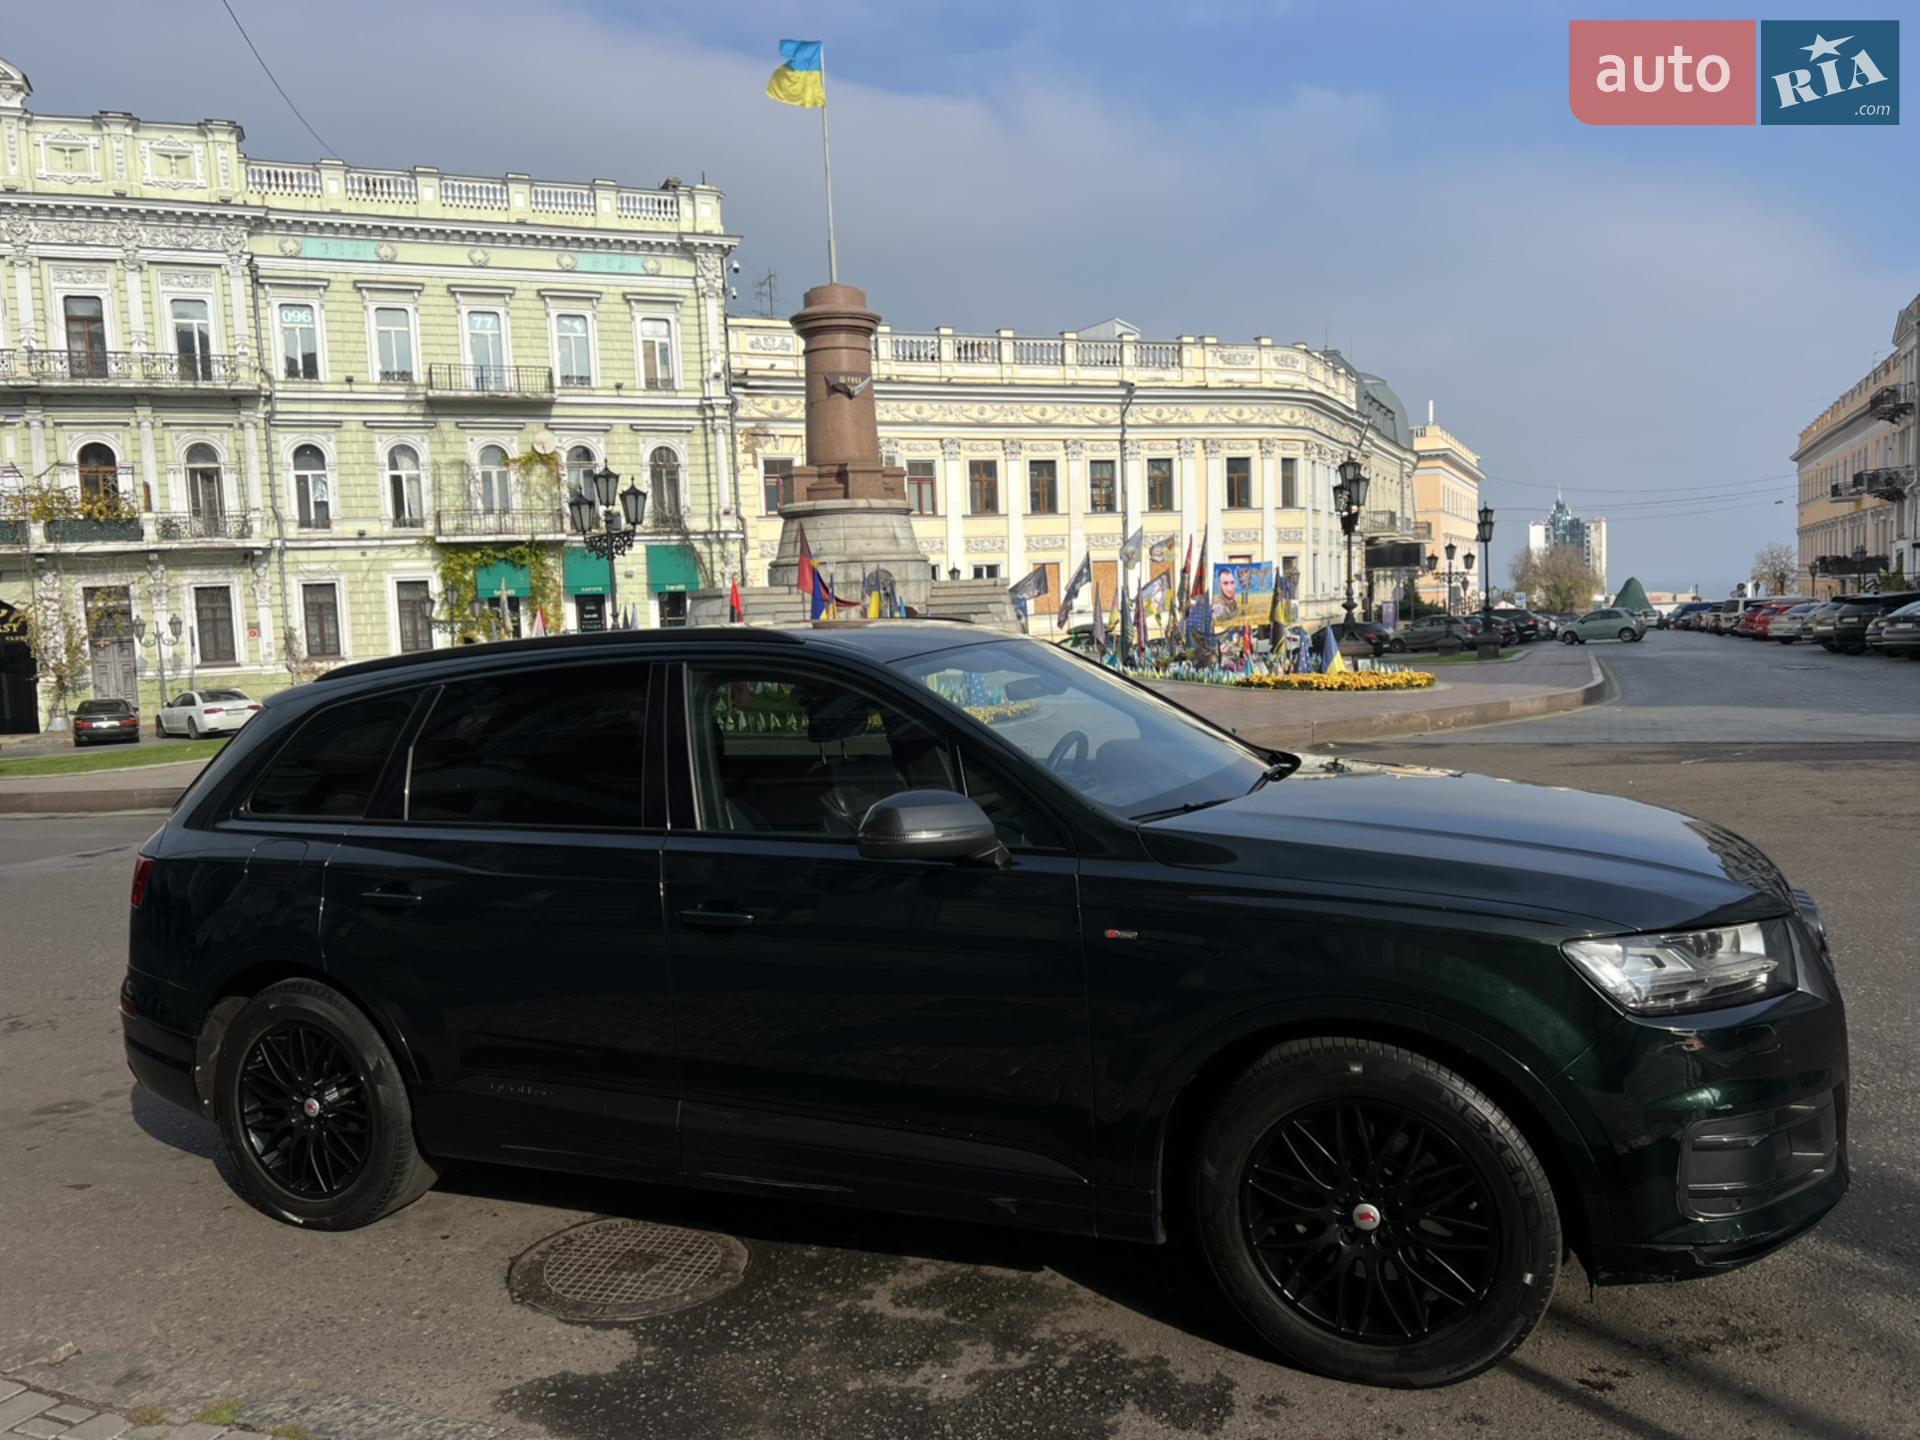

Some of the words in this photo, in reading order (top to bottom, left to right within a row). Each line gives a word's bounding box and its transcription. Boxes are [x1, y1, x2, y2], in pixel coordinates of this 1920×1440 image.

[281, 309, 312, 323] 096
[472, 317, 494, 329] 77
[1439, 1087, 1534, 1196] NEXEN
